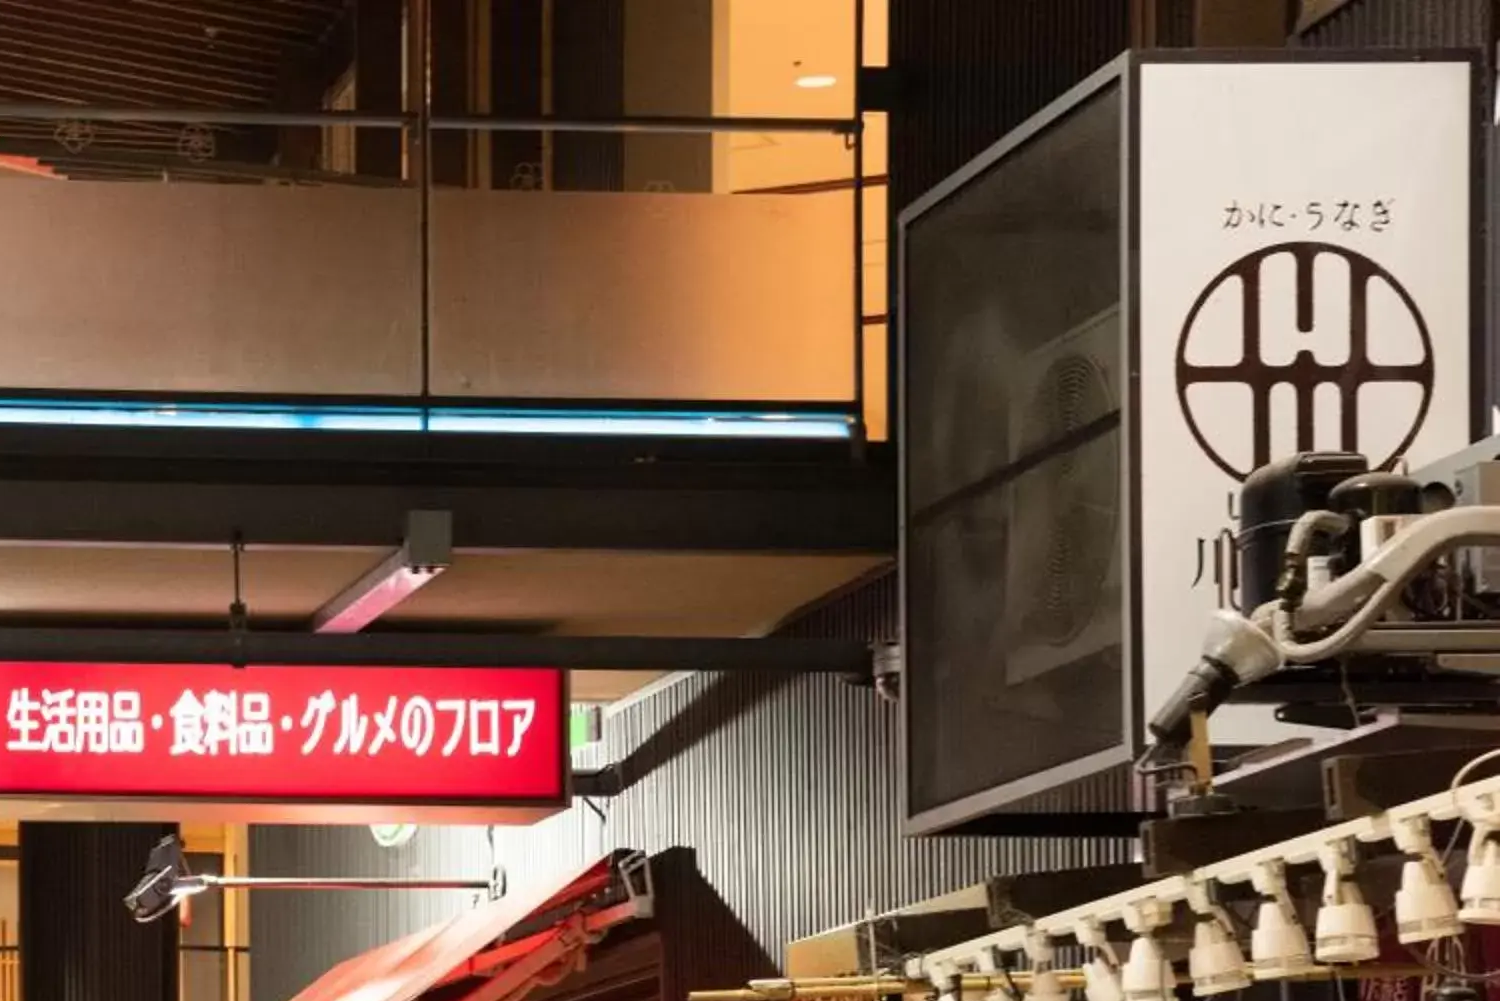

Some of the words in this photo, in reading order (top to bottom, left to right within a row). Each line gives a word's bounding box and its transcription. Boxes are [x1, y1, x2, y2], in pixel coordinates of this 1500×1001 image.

[1222, 198, 1396, 233] かに・うなぎ
[5, 686, 536, 757] 生活用品・食料品・グルメのフロア
